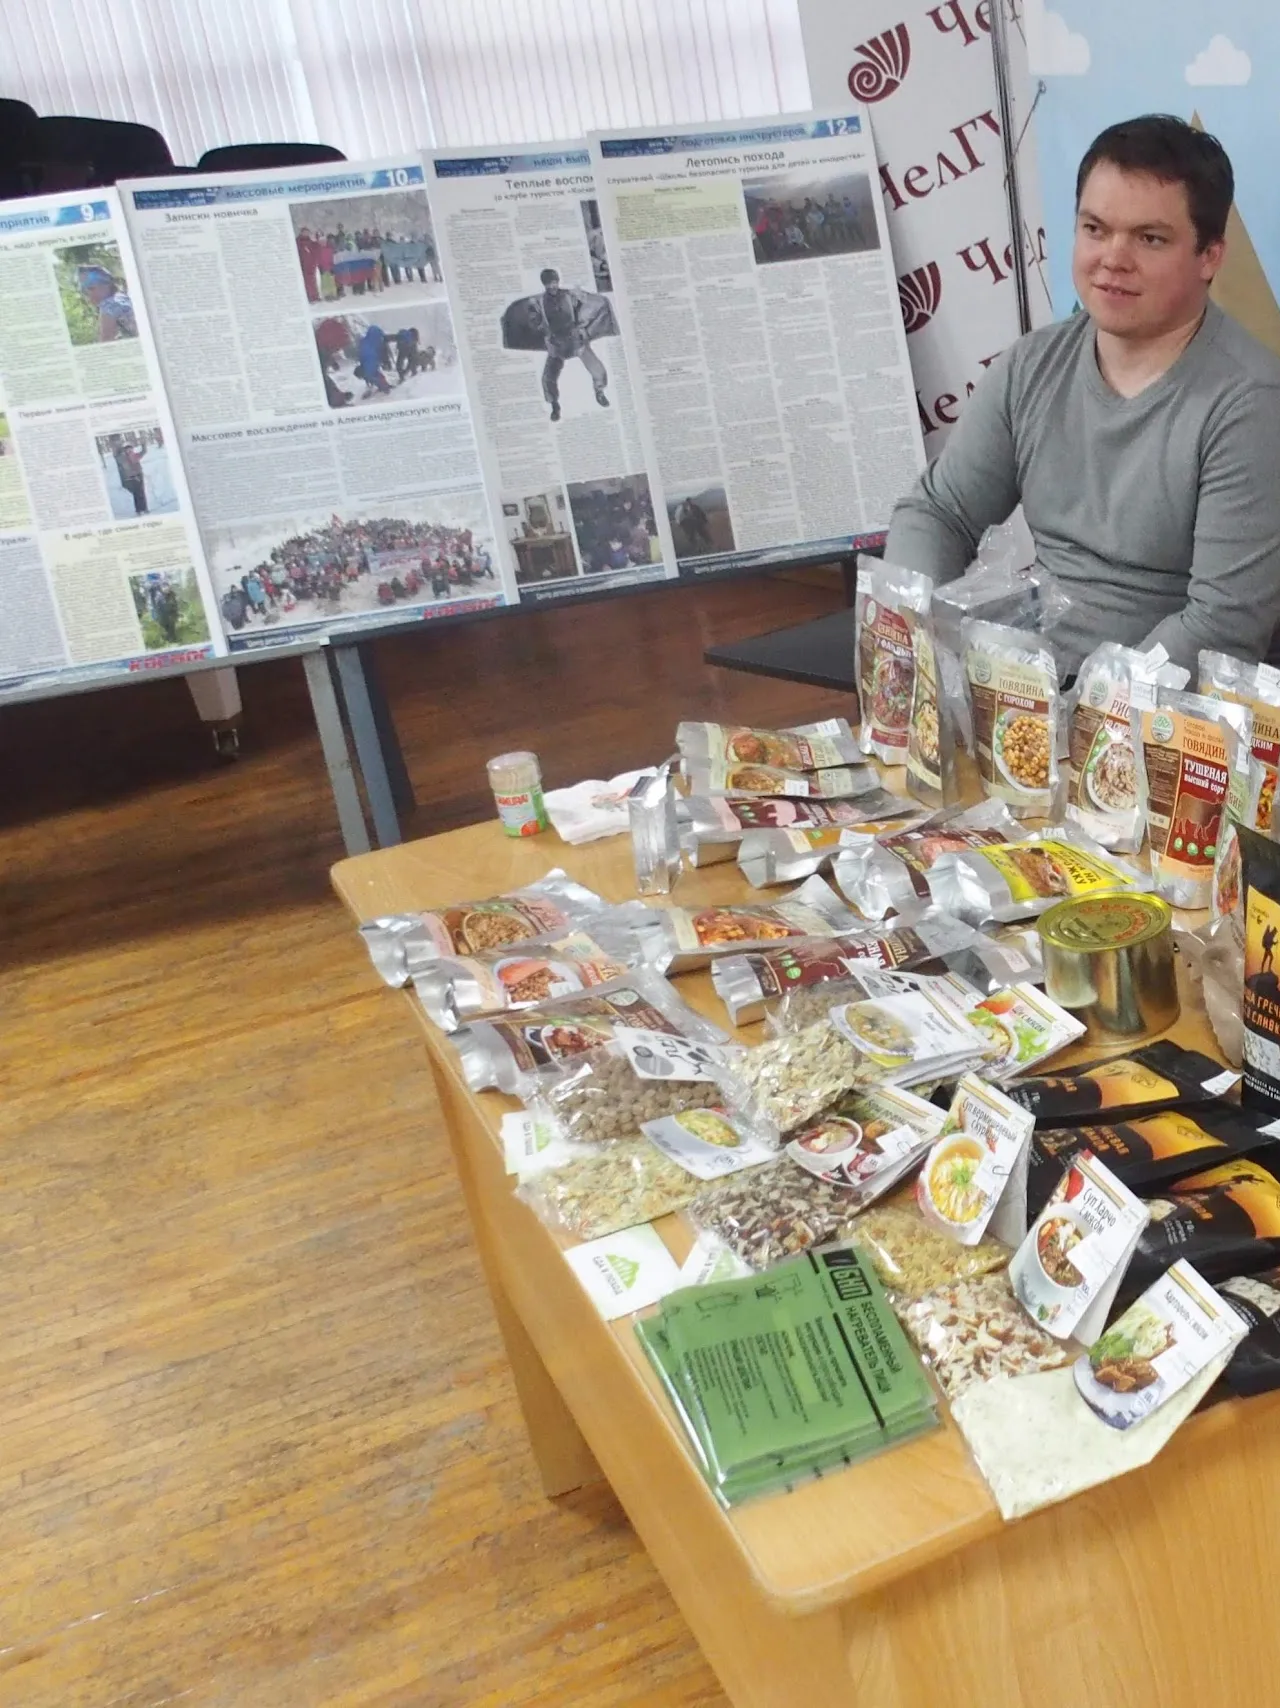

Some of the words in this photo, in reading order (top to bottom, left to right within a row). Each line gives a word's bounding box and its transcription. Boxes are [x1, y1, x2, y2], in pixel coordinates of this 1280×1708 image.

[827, 119, 848, 136] 12
[686, 156, 740, 168] Летопись
[743, 151, 785, 163] похода
[226, 184, 285, 200] массовые
[288, 176, 367, 195] мероприятия
[386, 170, 409, 187] 10
[505, 177, 552, 191] Теплые
[0, 215, 50, 230] приятия
[81, 204, 95, 221] 9
[164, 211, 211, 224] Записки
[213, 208, 259, 221] новичка
[190, 430, 243, 443] Массовое
[246, 420, 319, 438] восхождение
[321, 418, 335, 428] на
[337, 405, 431, 427] Александровскую
[432, 401, 463, 416] сопку
[1000, 679, 1045, 698] ГОВЯДИНА
[1003, 694, 1035, 710] ГОРОХОМ
[1252, 721, 1280, 740] ДИНА
[1182, 735, 1228, 761] ГОВЯДИН
[1183, 758, 1228, 784] ТУШЕНАЯ
[1183, 773, 1209, 789] высший
[1210, 783, 1225, 796] сорт
[1083, 1188, 1098, 1207] Суп
[1094, 1199, 1117, 1228] Харчо
[1082, 1210, 1105, 1236] мясом
[833, 1268, 870, 1300] БНП
[861, 1300, 903, 1375] БЕСПЛАМЕННЫЙ
[846, 1305, 880, 1371] НАГРЕВАТЕЛЬ
[872, 1368, 891, 1395] ПИЩИ
